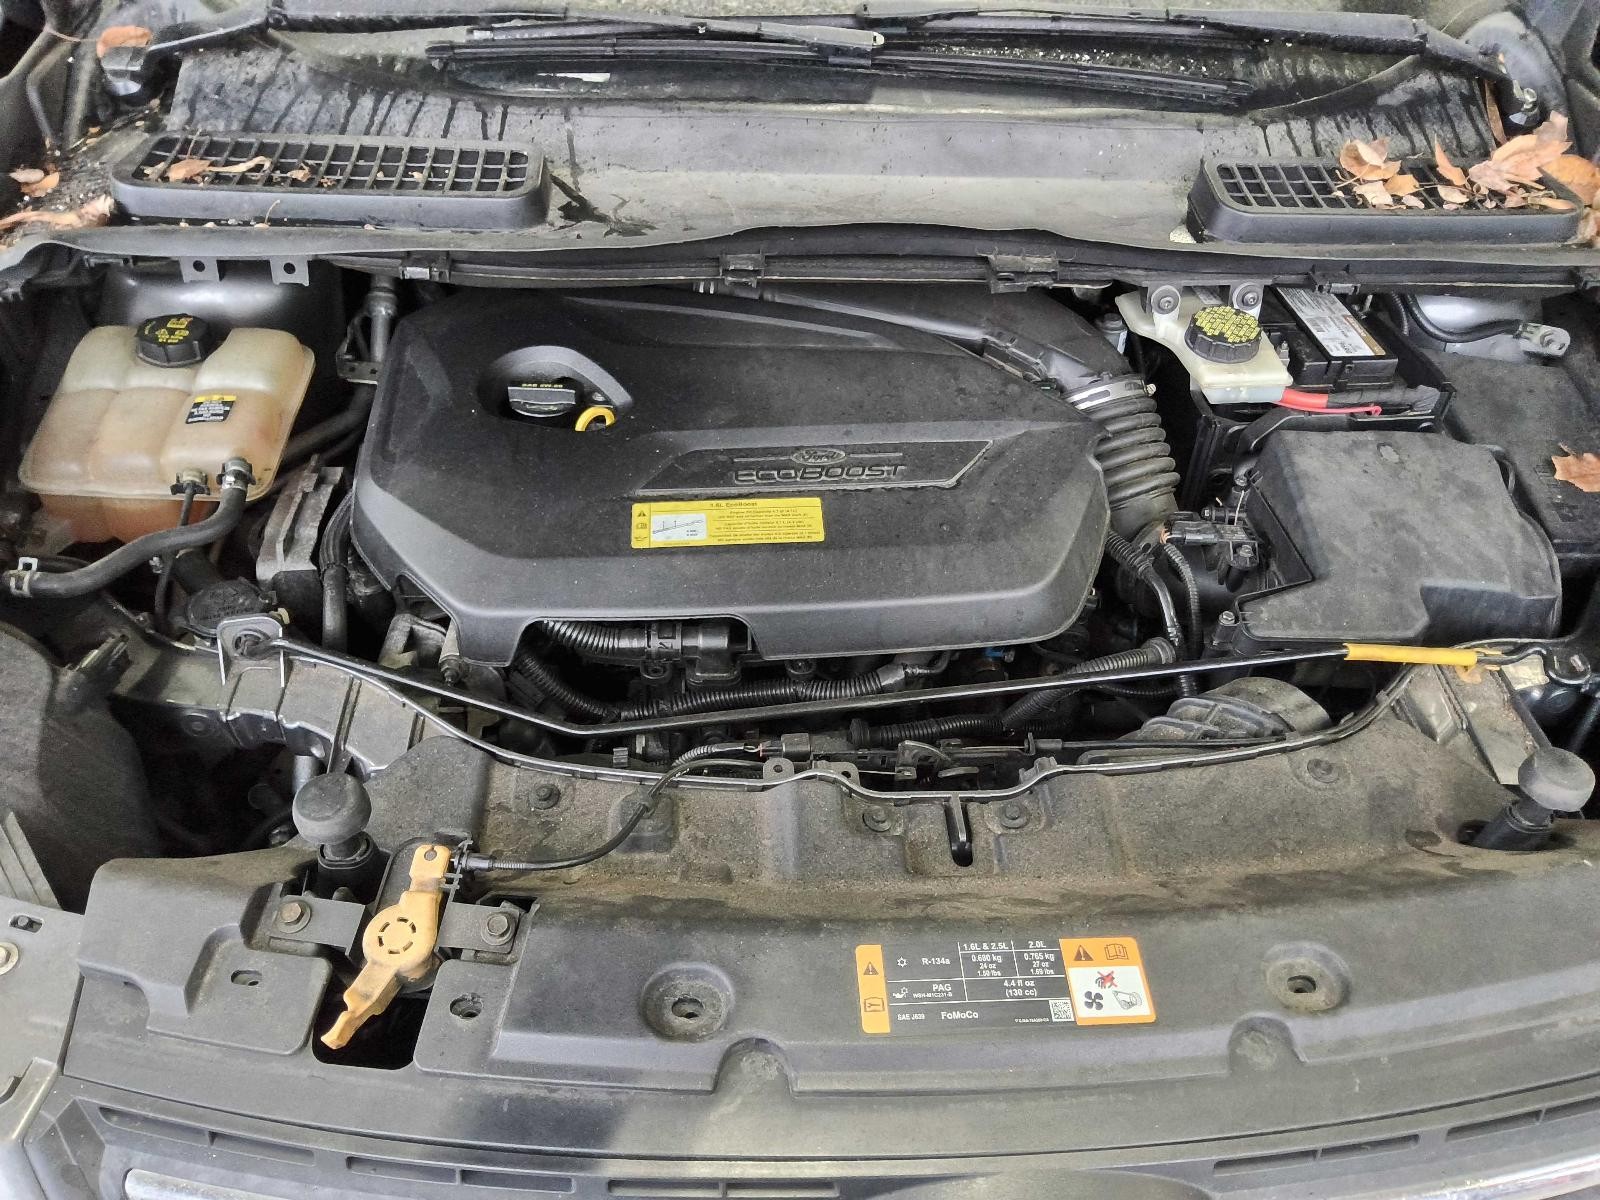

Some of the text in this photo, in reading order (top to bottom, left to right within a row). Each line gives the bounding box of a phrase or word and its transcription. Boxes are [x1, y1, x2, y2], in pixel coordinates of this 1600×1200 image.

[983, 942, 989, 950] &
[991, 942, 1009, 950] 2.5L
[1028, 940, 1047, 949] 2.0L
[992, 953, 1002, 963] kg
[1044, 952, 1055, 961] kg
[921, 957, 951, 966] R-134a
[932, 983, 952, 992] PAG
[1003, 979, 1016, 987] 4.4
[1017, 979, 1023, 987] fl
[1005, 988, 1038, 998] (130 cc)
[897, 1013, 911, 1021] SAE
[940, 1010, 979, 1020] FoMoCo
